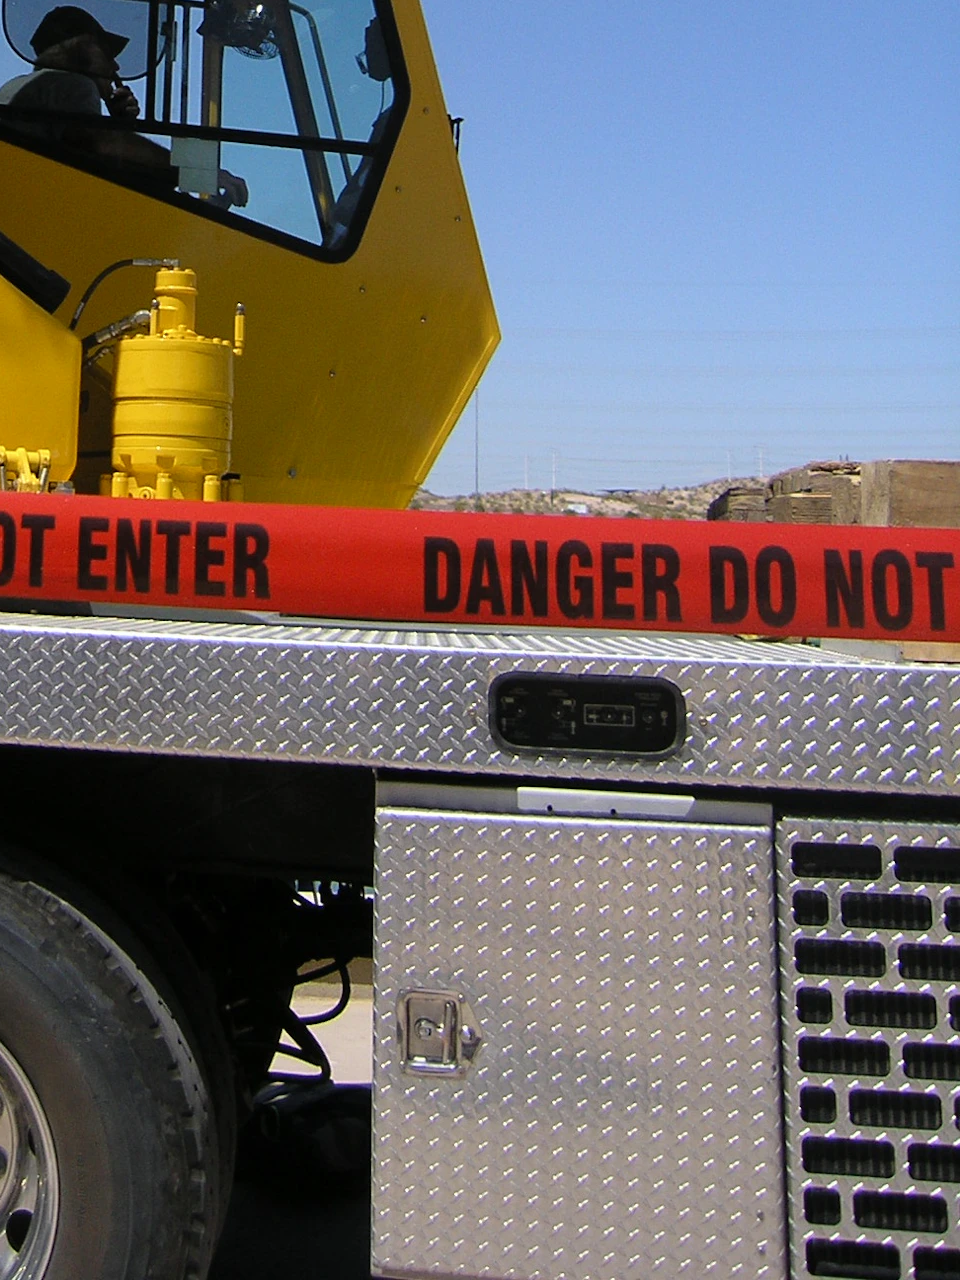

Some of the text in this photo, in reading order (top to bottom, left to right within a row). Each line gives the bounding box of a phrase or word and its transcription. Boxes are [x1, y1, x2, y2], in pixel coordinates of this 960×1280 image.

[76, 516, 272, 600] ENTER
[423, 536, 684, 622] DANGER
[708, 545, 797, 628] DO
[824, 548, 955, 632] NOT
